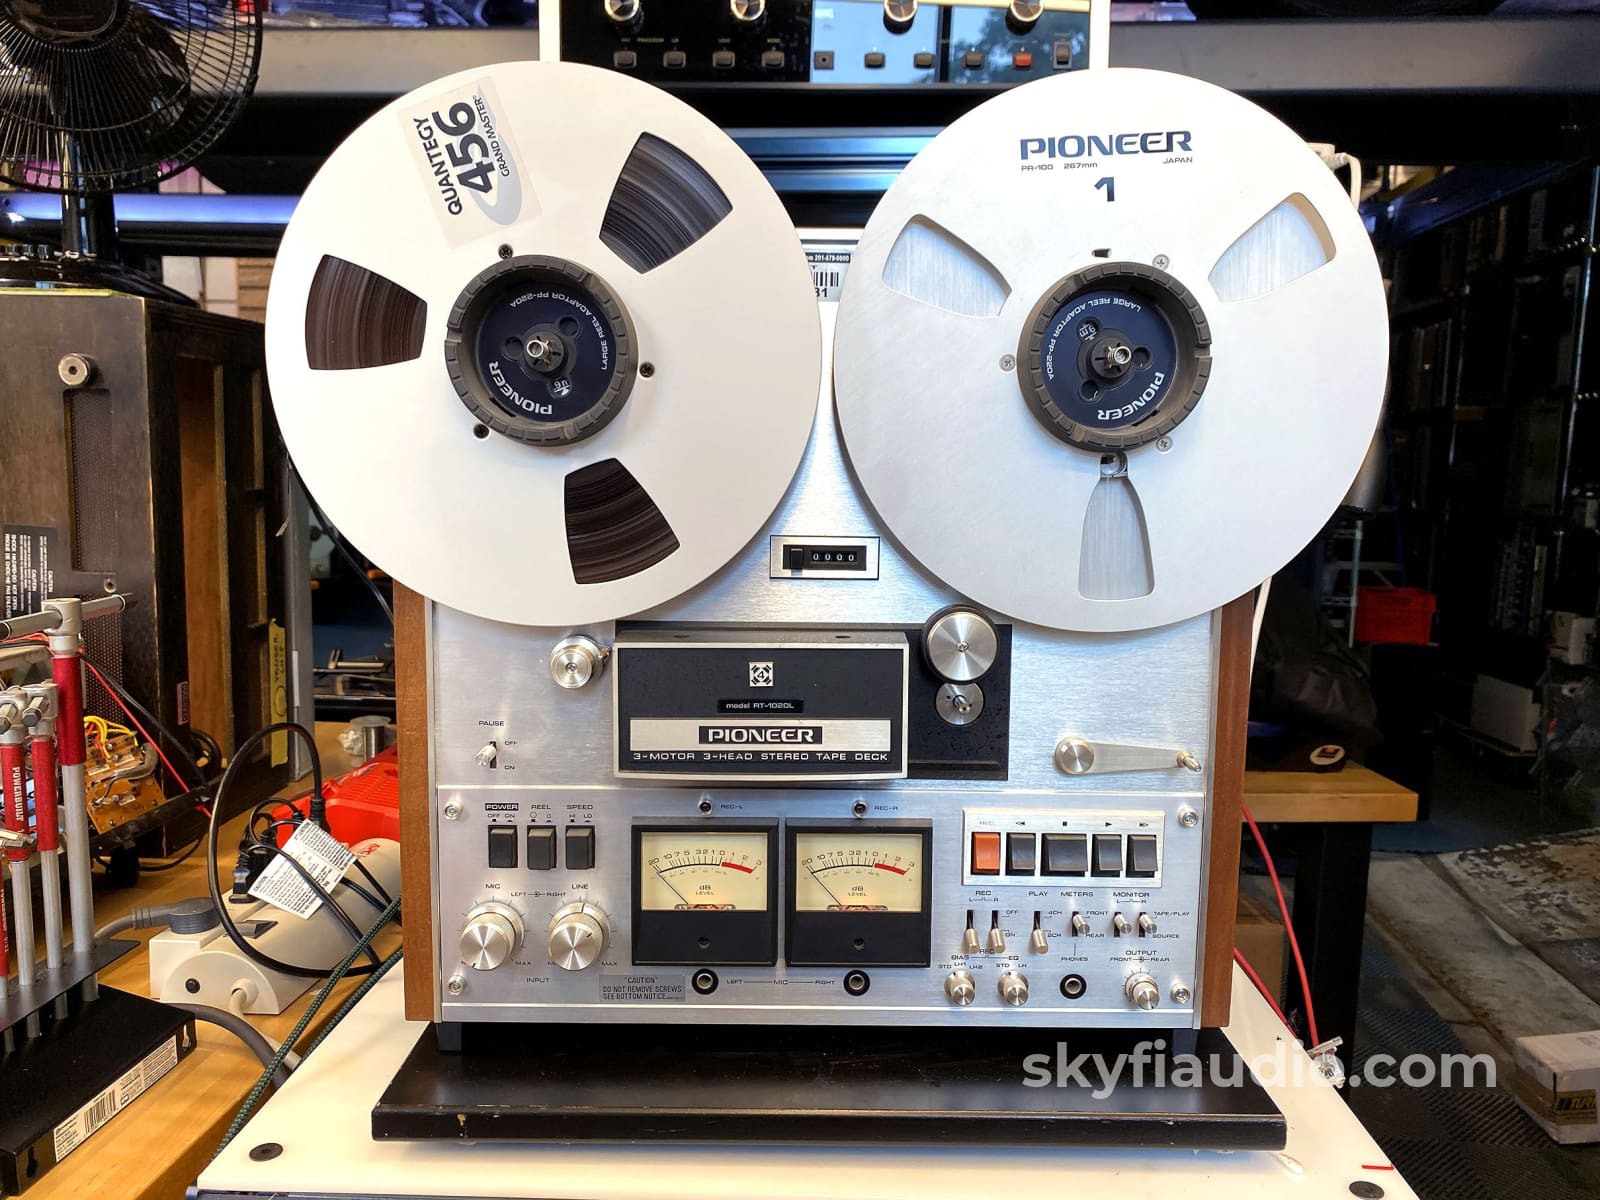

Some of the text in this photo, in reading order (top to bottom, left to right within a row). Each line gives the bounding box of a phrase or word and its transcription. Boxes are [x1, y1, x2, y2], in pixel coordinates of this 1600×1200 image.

[431, 101, 496, 194] 456
[490, 140, 510, 177] GRAND
[1020, 130, 1193, 160] PIONEER
[413, 117, 463, 216] QUANTEGY
[1021, 162, 1098, 172] PR-100 267mm
[1162, 157, 1193, 165] JAPAN
[1094, 176, 1115, 202] 1
[1088, 297, 1111, 307] REEL
[1112, 297, 1142, 313] LARGE
[510, 292, 608, 370] LARGE REEL ADAPTOR PP-220A
[1053, 304, 1086, 338] ADAPTOR
[1046, 339, 1057, 381] PP-220A
[488, 360, 553, 415] PIONEER
[1097, 371, 1165, 421] PIONEER
[708, 728, 814, 743] PIONEER
[633, 752, 888, 761] 3-MOTOR 3-HEAD STEREO TAPE DECK
[12, 766, 25, 822] POWERBUILT
[648, 857, 660, 866] 20
[801, 858, 813, 866] 20
